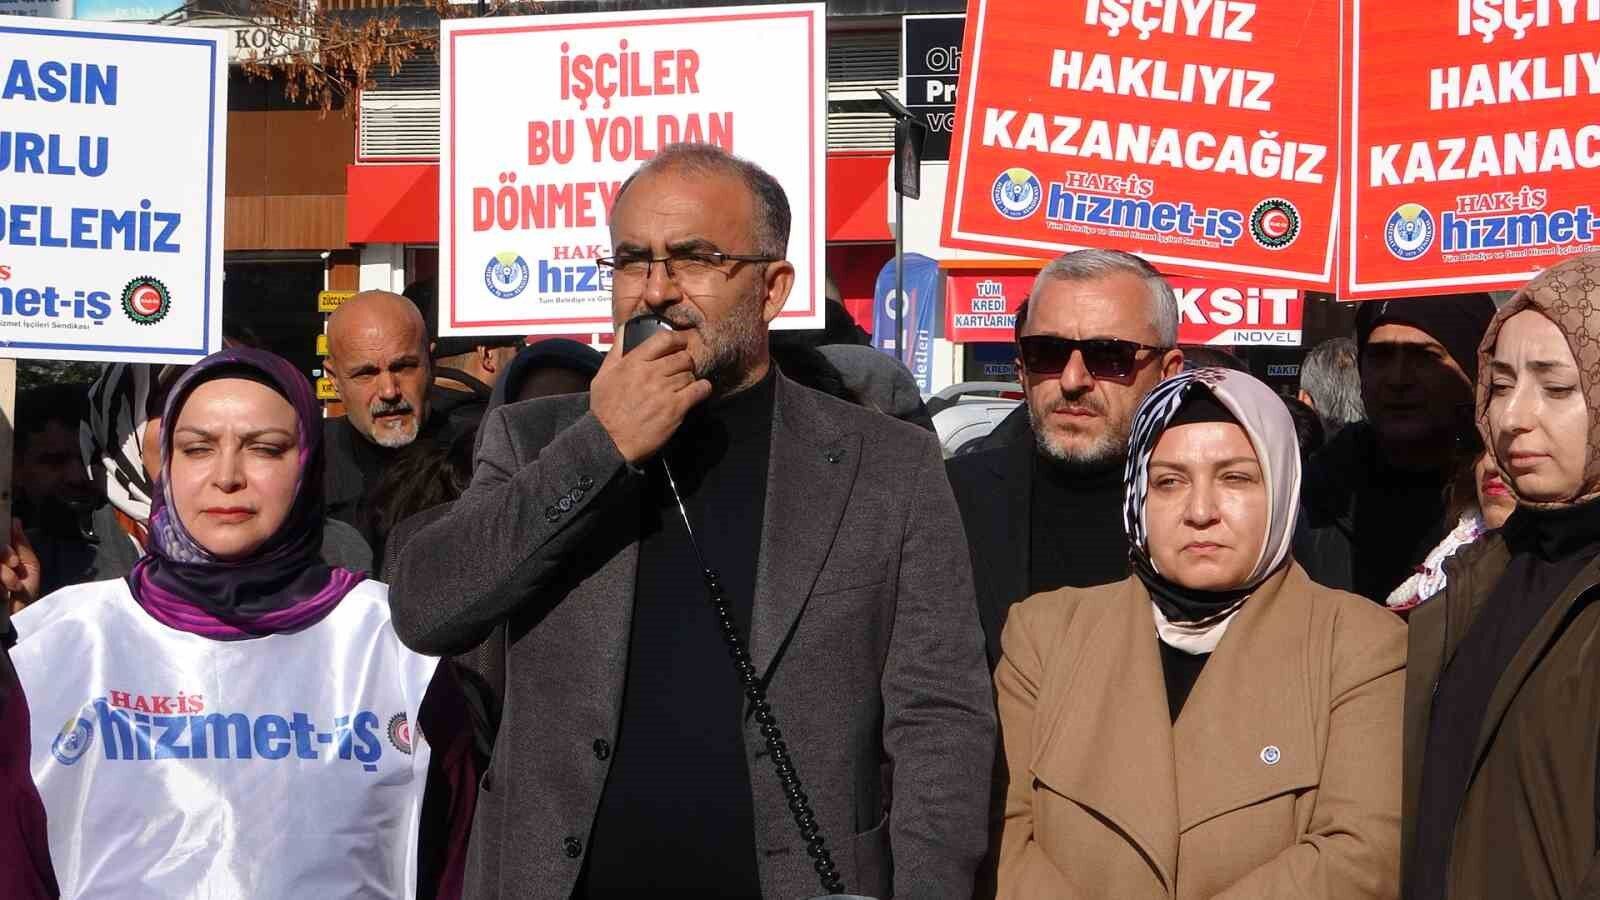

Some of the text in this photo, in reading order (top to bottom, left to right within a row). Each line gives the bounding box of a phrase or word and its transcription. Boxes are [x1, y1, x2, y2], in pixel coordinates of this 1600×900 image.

[2, 59, 118, 105] ASIN
[560, 39, 699, 110] İŞÇİLER
[1050, 49, 1275, 111] HAKLIYIZ
[1430, 52, 1600, 110] HAKLIY
[527, 120, 574, 165] BU
[982, 107, 1327, 183] KAZANACAĞIZ
[1370, 125, 1600, 187] KAZANAC
[0, 198, 181, 253] ELEMİZ
[1048, 184, 1242, 246] hizmet-iş
[977, 280, 1001, 295] TÜM
[954, 314, 1016, 327] KARTLARIN
[1233, 331, 1297, 343] INOVEL
[94, 697, 383, 772] hizmet-iş
